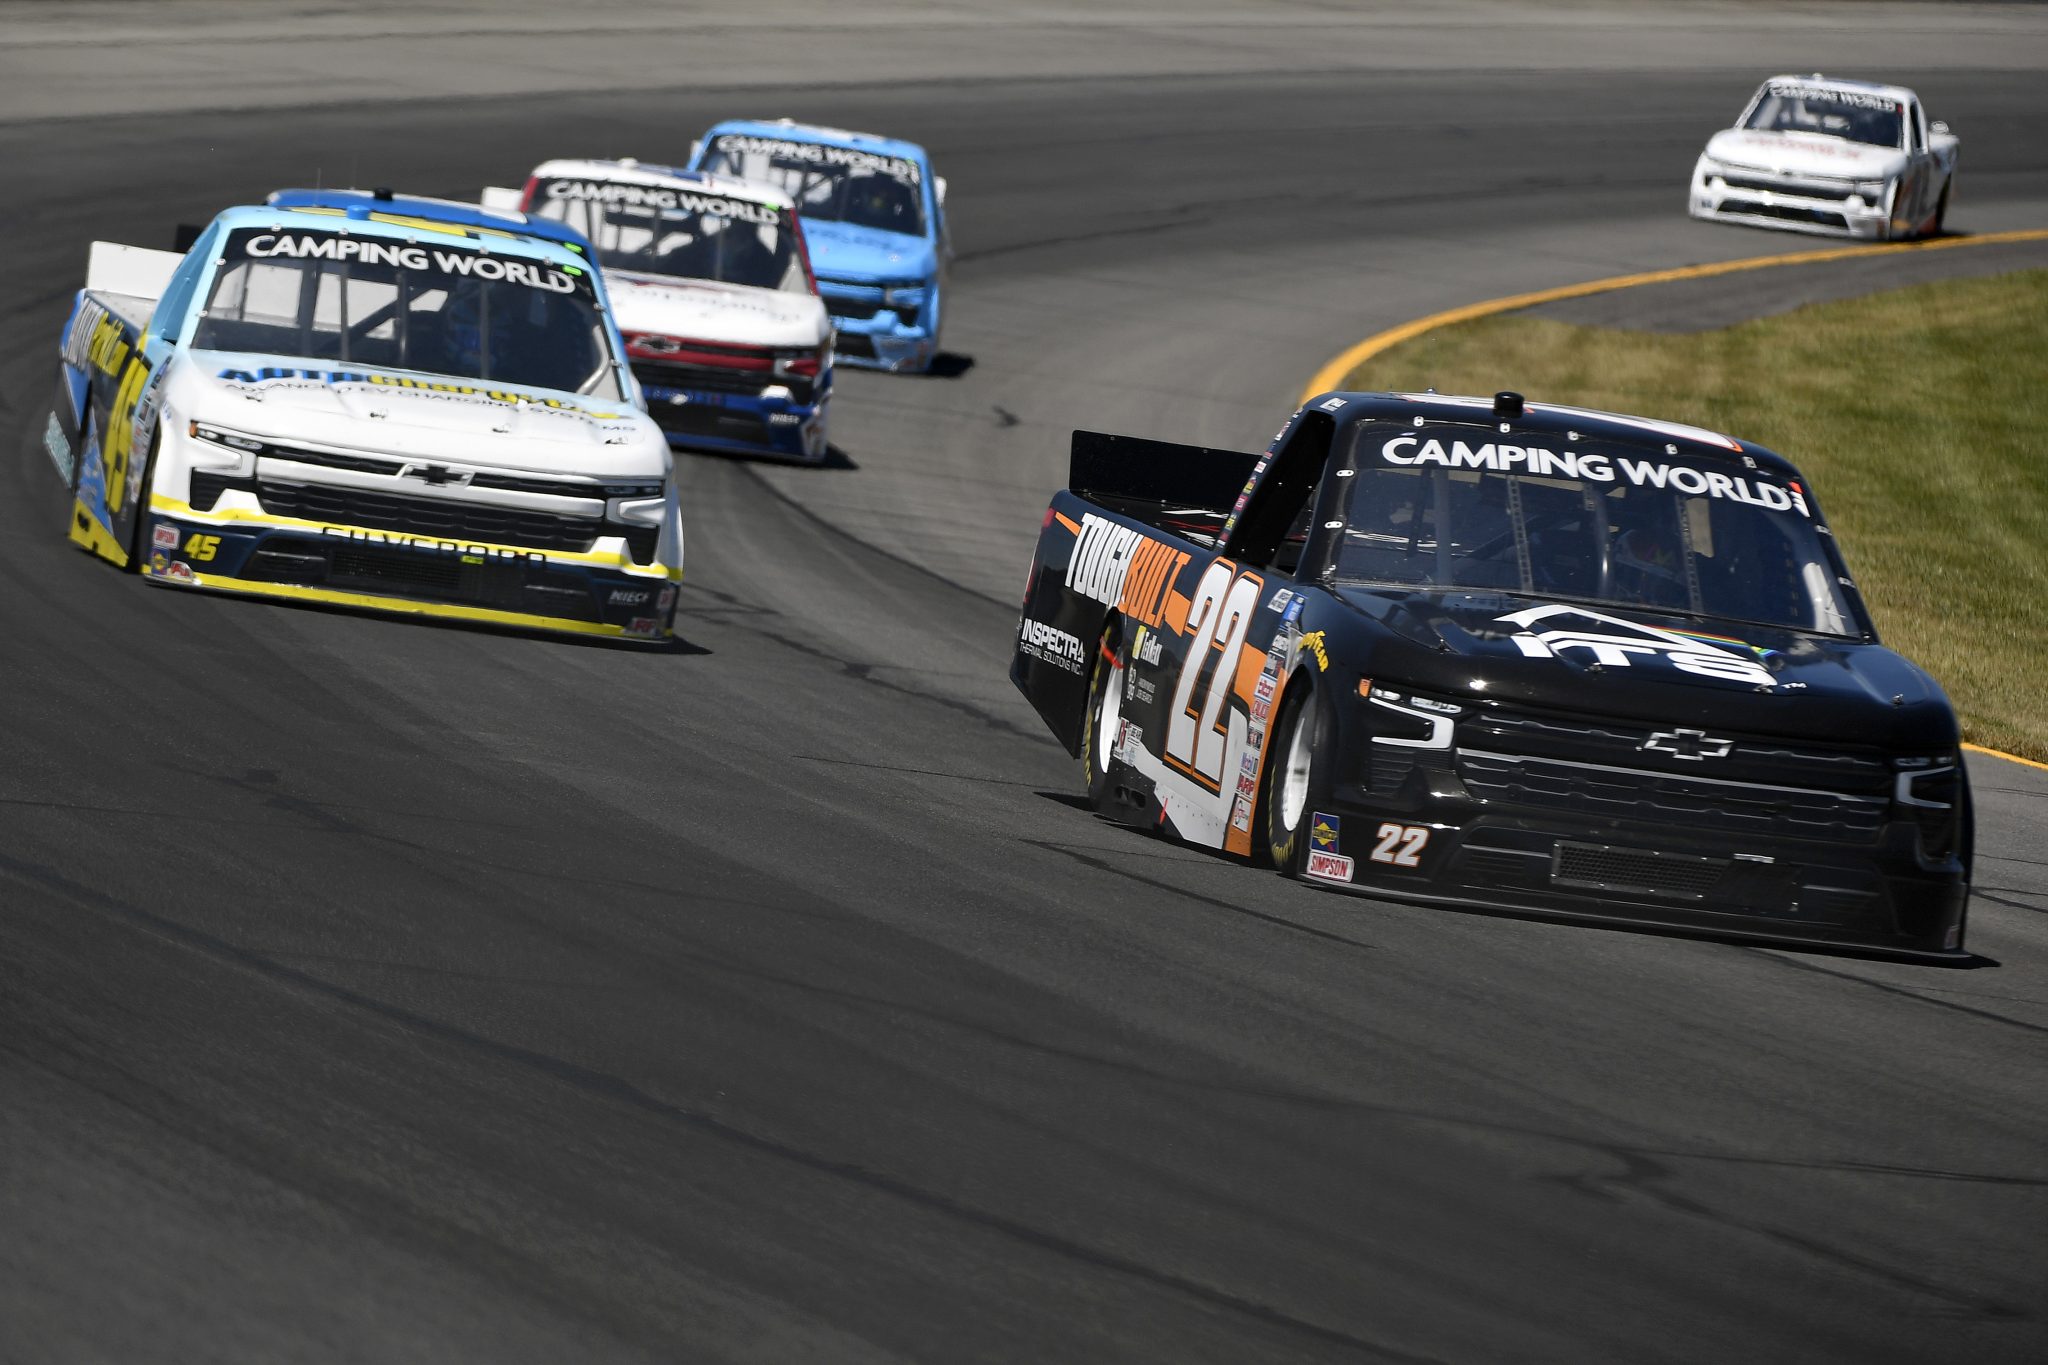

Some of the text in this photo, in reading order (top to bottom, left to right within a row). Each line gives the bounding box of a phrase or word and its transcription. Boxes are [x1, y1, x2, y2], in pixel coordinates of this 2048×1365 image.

[718, 135, 911, 177] CAMPING WORLD
[546, 180, 780, 225] CAMPING WORLD
[247, 235, 576, 293] CAMPING WORLD
[1382, 437, 1792, 511] CAMPING WORLD
[184, 533, 222, 562] 45
[1019, 641, 1043, 659] THERMAL
[1043, 650, 1071, 672] SOLUTIONS
[1021, 617, 1085, 664] INSPECTRA
[1164, 560, 1263, 790] 22
[1311, 855, 1349, 877] SIMPSON
[1370, 822, 1430, 868] 22
